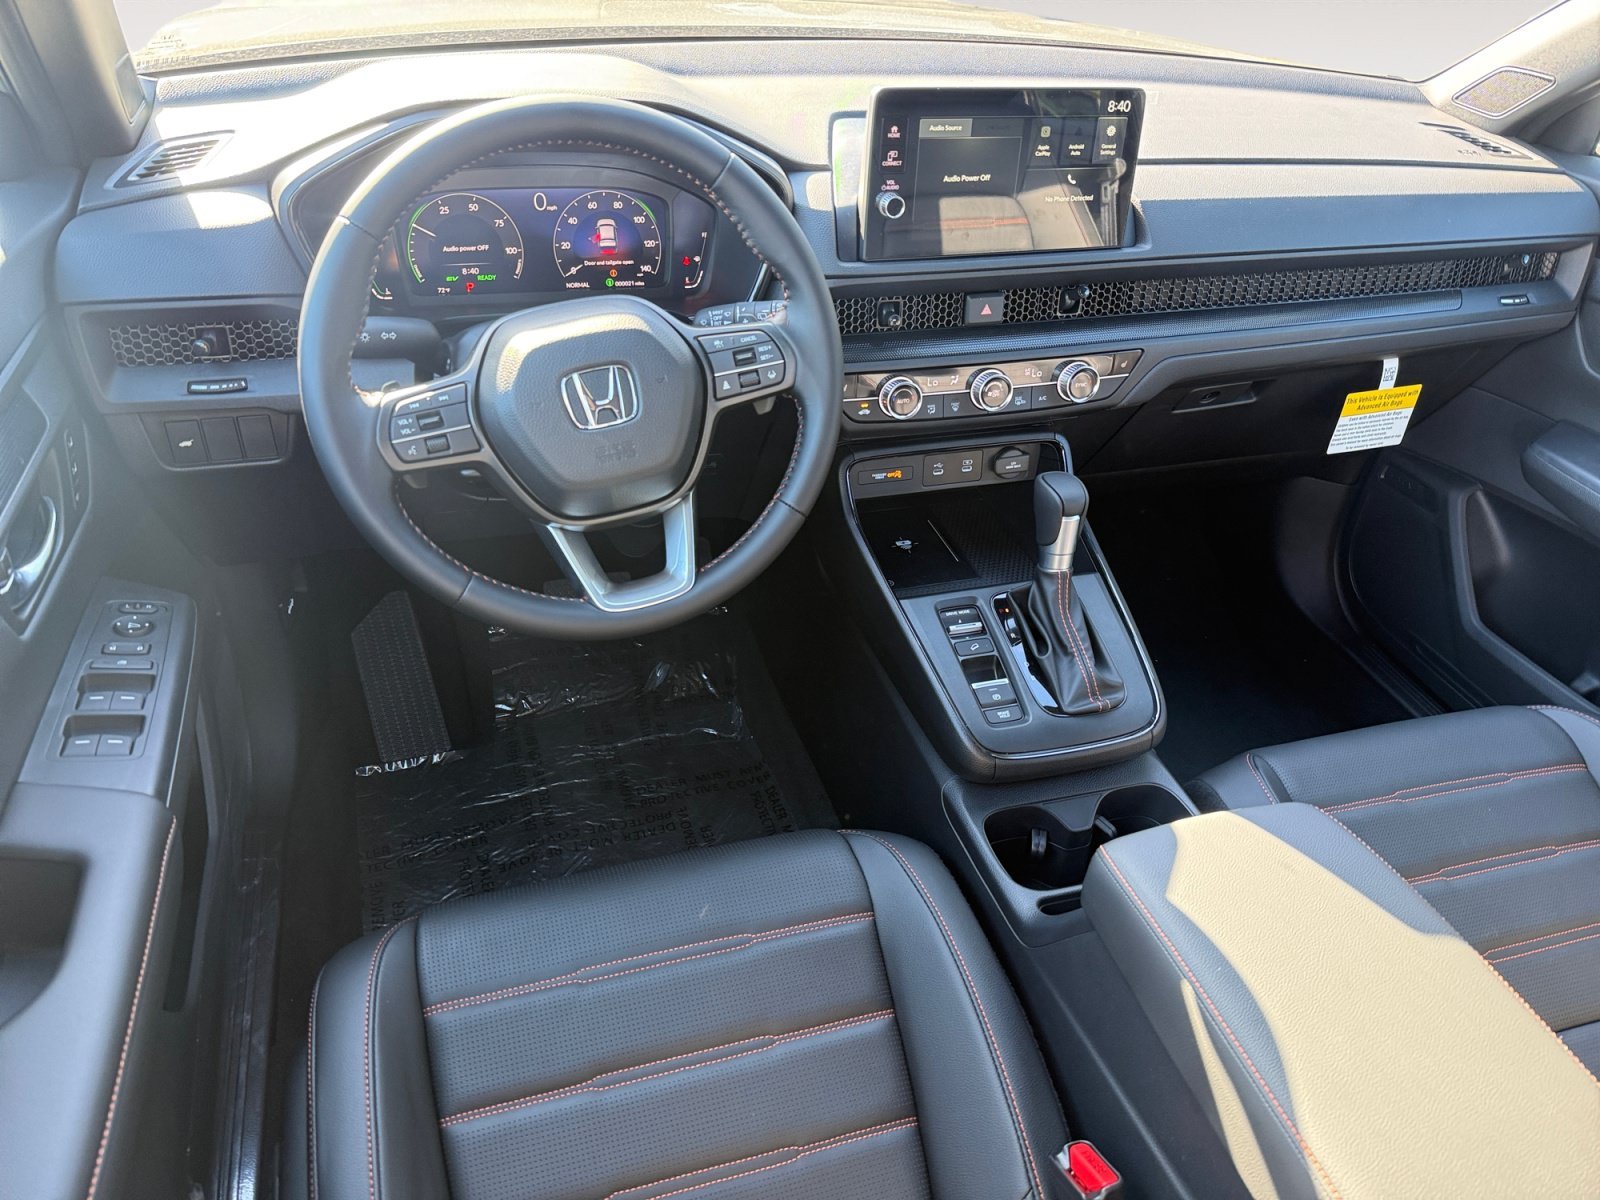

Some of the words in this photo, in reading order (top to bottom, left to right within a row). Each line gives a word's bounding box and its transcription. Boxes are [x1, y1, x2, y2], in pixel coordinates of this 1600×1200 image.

[1107, 100, 1131, 113] 8:40
[929, 124, 943, 132] Audio
[944, 124, 962, 132] Source
[943, 174, 960, 182] Audio
[961, 174, 980, 182] Power
[533, 192, 546, 210] 0
[468, 203, 479, 211] 50
[494, 219, 505, 227] 75
[633, 216, 646, 224] 100
[462, 267, 480, 275] 8:40
[466, 283, 475, 293] P
[740, 335, 757, 343] CANCEL
[1031, 368, 1043, 377] Lo
[927, 378, 938, 387] Lo
[1359, 396, 1377, 404] Vehicle
[1384, 392, 1407, 401] Equipped
[1357, 403, 1381, 411] Advanced
[1390, 400, 1403, 408] Bags
[726, 772, 771, 791] COVER
